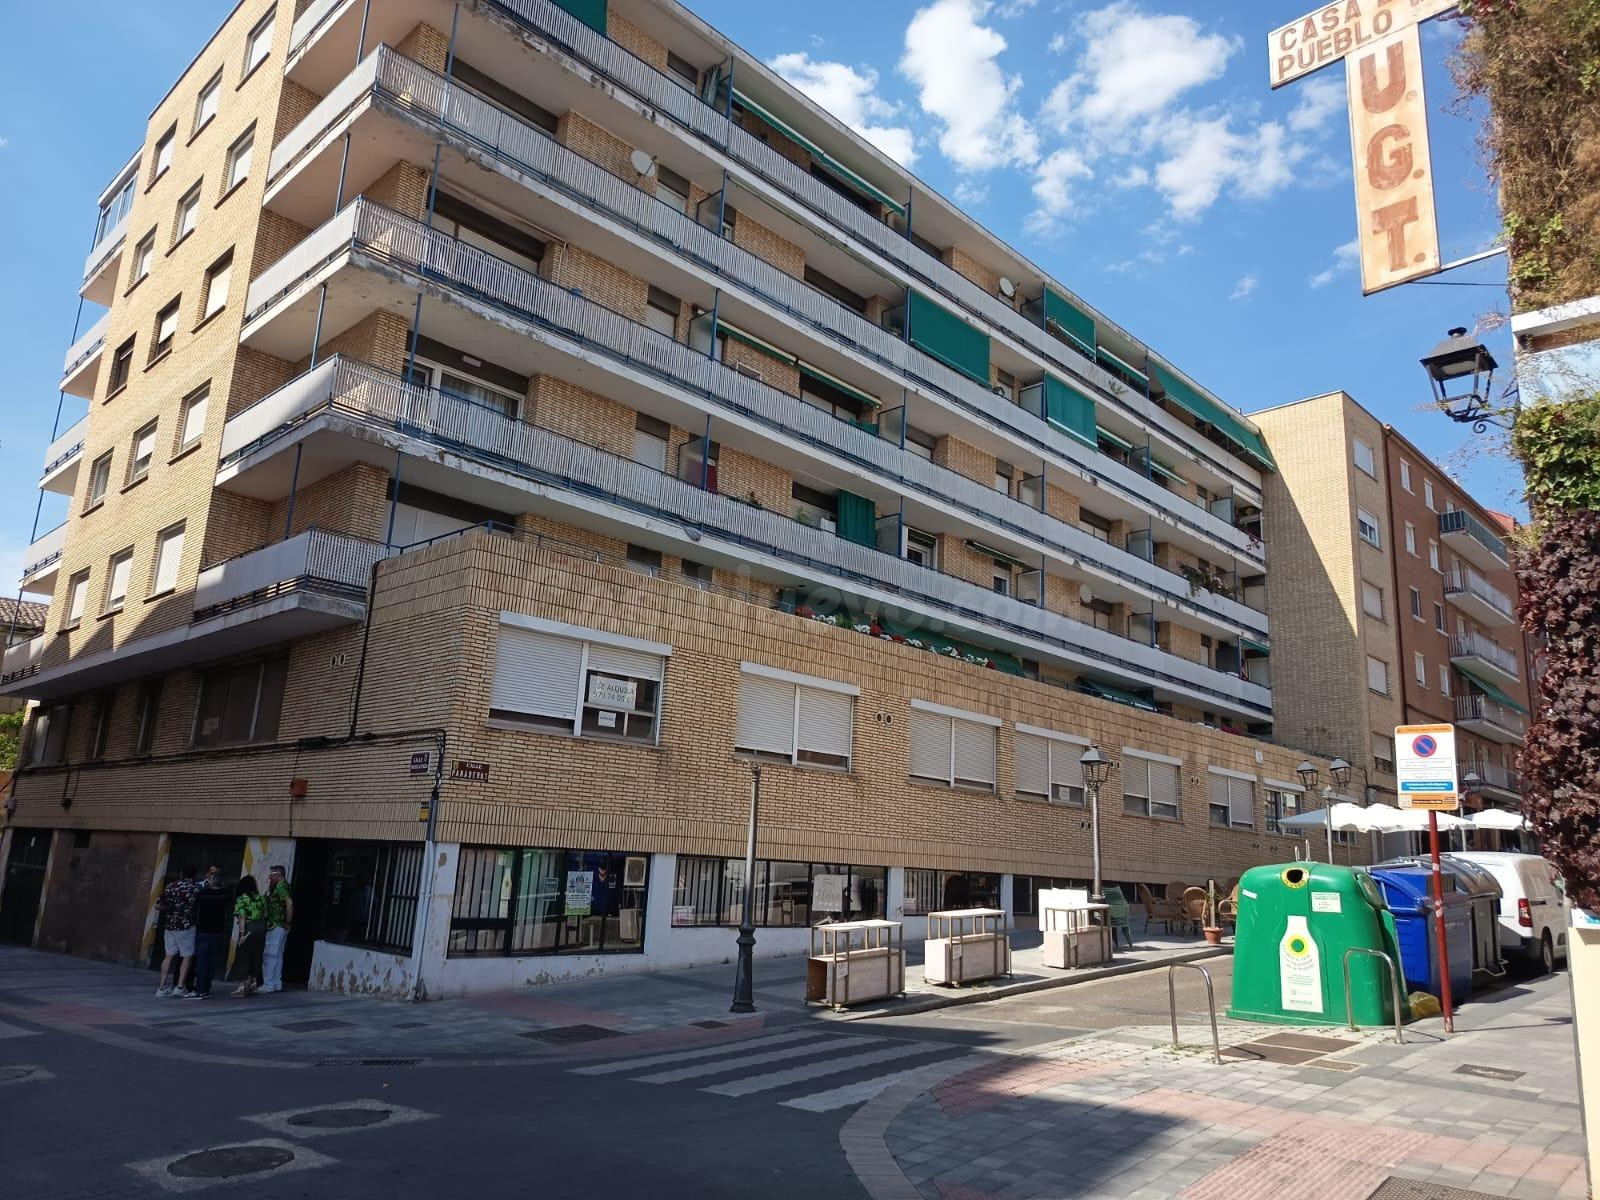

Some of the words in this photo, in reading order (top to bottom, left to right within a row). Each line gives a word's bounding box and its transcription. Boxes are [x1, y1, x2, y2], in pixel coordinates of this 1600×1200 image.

[1278, 9, 1393, 80] PUEBLO
[1280, 0, 1362, 51] CASA
[466, 762, 483, 770] CALLE
